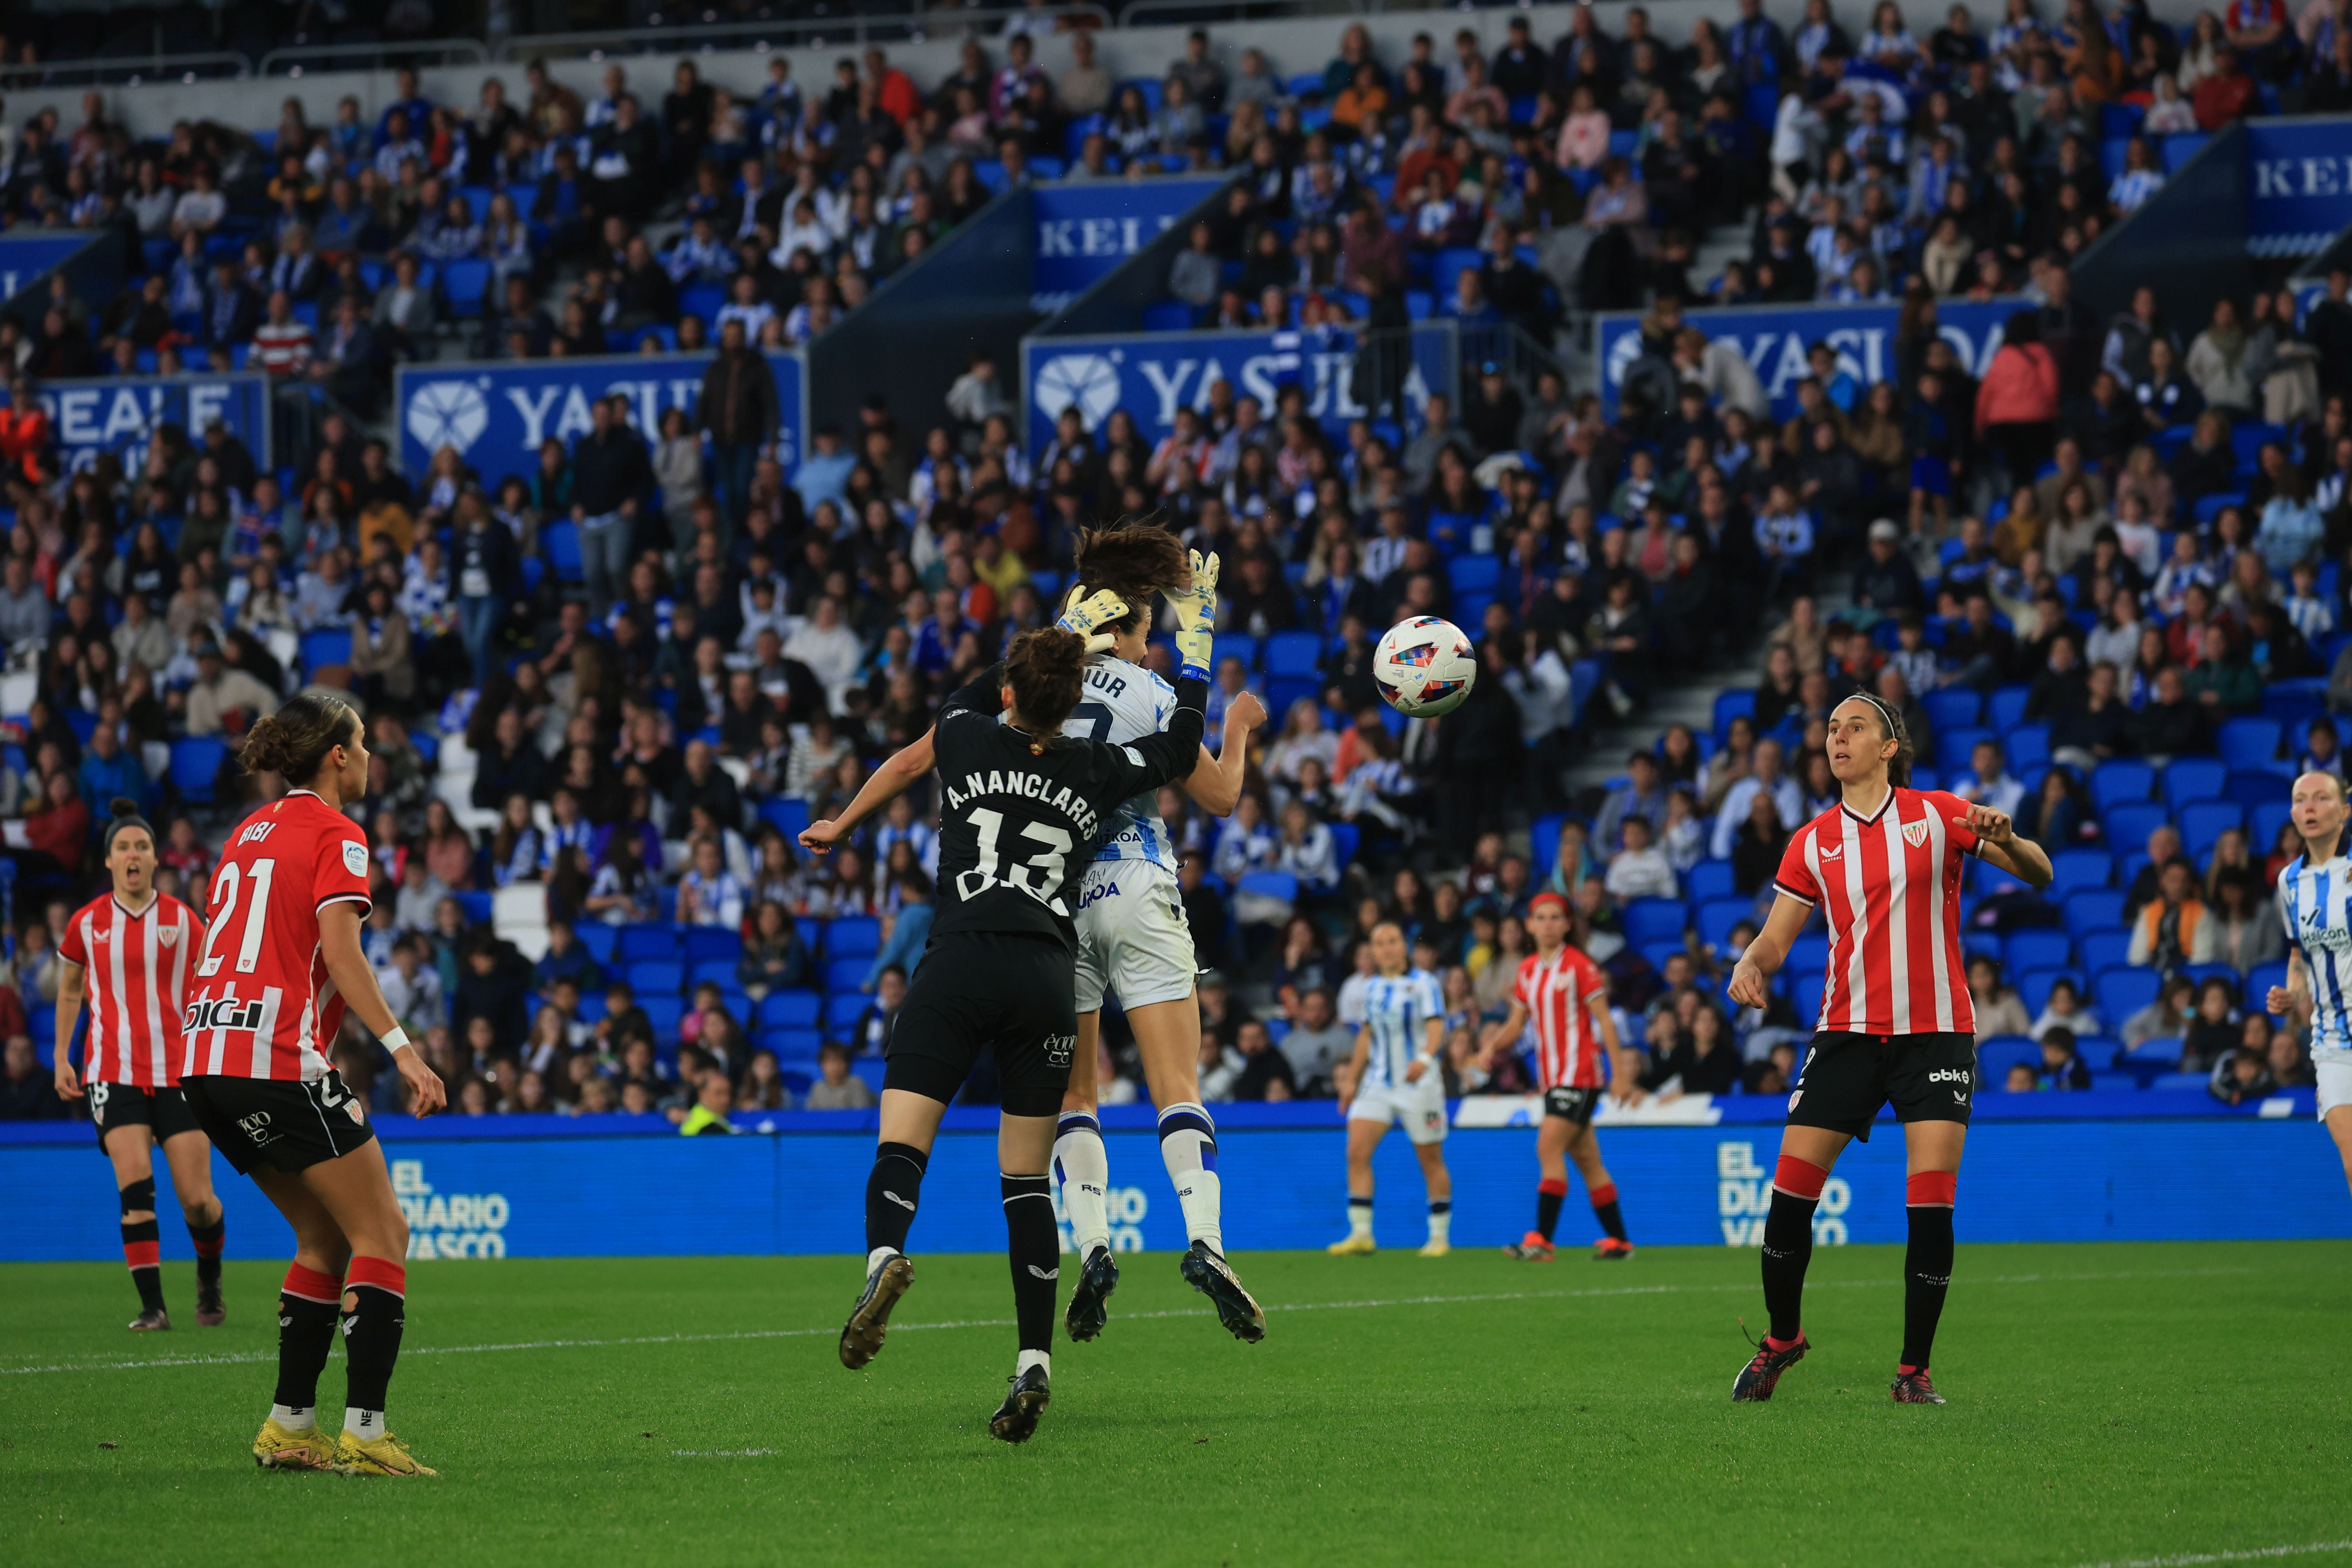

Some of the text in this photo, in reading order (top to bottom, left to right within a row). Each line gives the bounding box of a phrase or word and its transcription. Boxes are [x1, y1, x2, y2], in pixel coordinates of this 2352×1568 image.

[947, 770, 1098, 841] A.NANCLARES
[237, 821, 277, 847] BIBI
[966, 807, 1074, 902] 13
[198, 858, 275, 977] 21
[183, 1000, 263, 1032] DIGI
[392, 1159, 434, 1195] EL
[1717, 1142, 1765, 1179] EL
[1082, 1184, 1101, 1196] RS
